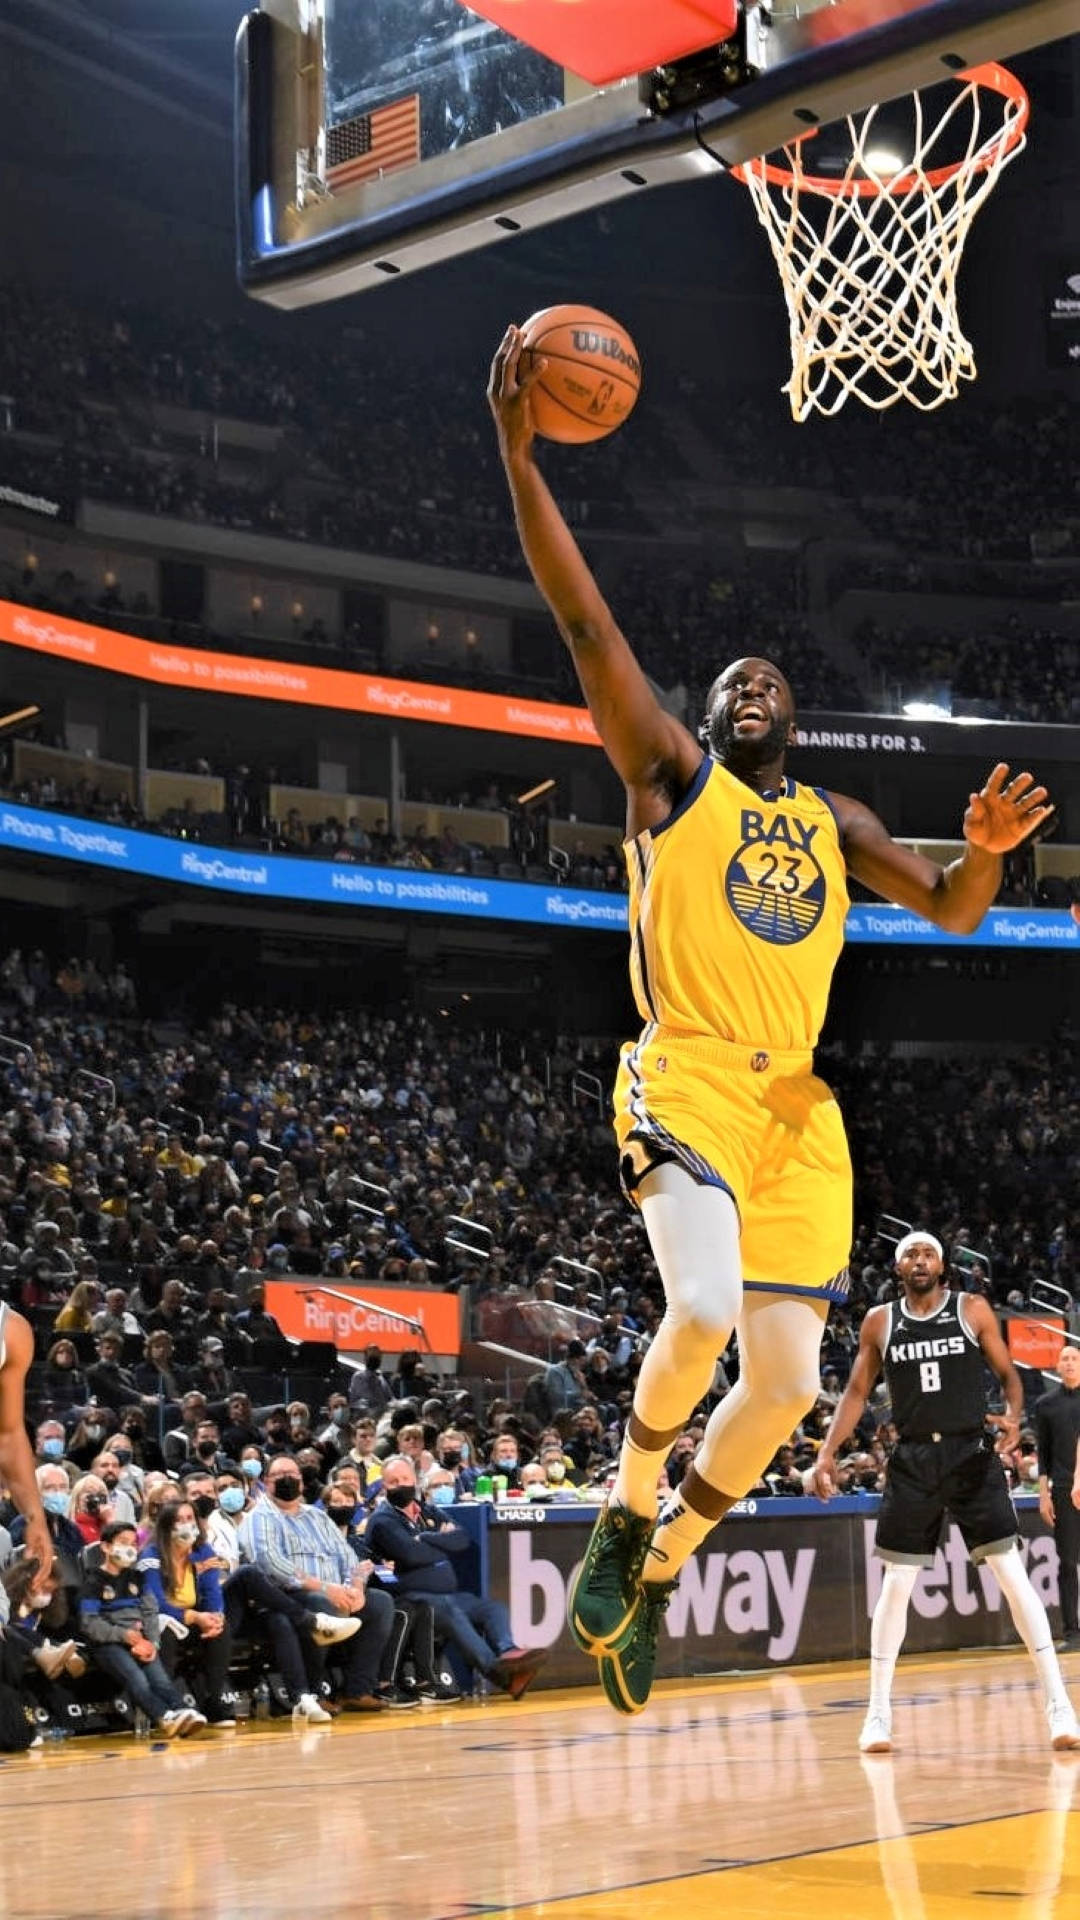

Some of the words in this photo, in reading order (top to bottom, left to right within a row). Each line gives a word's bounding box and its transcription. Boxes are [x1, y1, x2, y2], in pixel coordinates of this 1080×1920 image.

[150, 652, 190, 673] Hello
[194, 662, 213, 677] to
[214, 665, 308, 691] possibilities
[366, 684, 451, 714] RingCentral
[796, 730, 868, 750] BARNES
[870, 734, 906, 752] FOR
[910, 736, 926, 752] 3.
[740, 808, 819, 854] BAY
[181, 851, 268, 885] RingCentral
[757, 852, 802, 893] 23
[332, 872, 374, 894] Hello
[376, 878, 395, 895] to
[396, 881, 489, 905] possibilities
[546, 895, 627, 921] RingCentral
[865, 915, 936, 936] Together.
[993, 919, 1078, 940] RingCentral
[890, 1335, 965, 1362] KINGS
[920, 1361, 941, 1392] 8
[508, 1530, 816, 1661] bway
